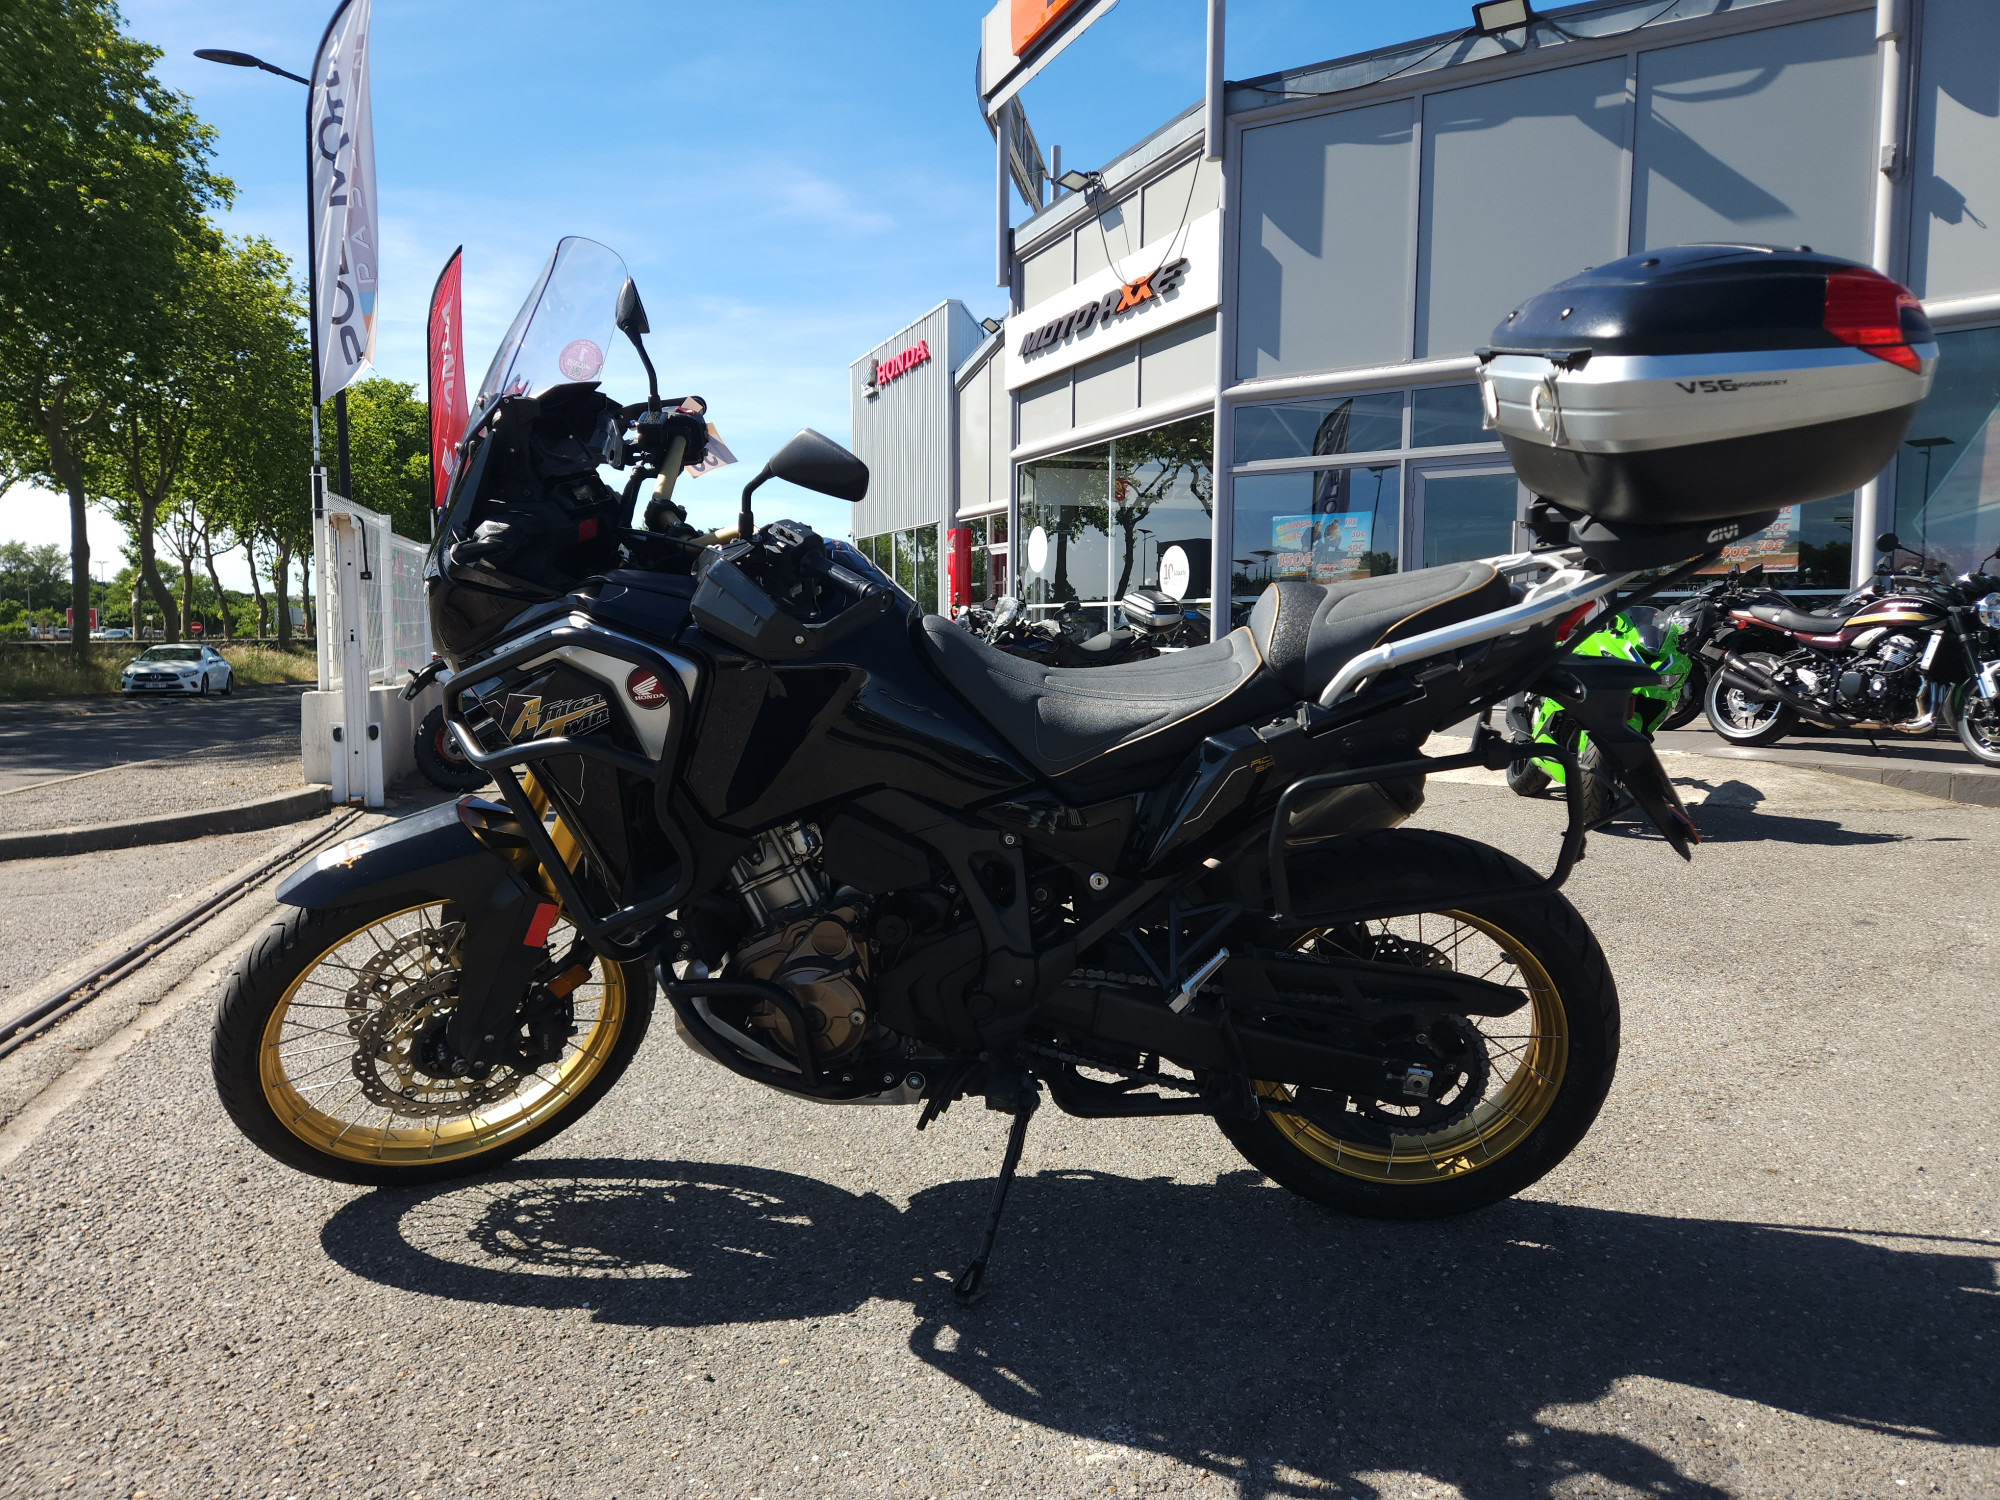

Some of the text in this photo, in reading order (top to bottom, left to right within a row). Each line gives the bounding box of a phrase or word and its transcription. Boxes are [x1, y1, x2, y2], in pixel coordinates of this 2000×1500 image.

[876, 340, 930, 386] HONDA
[1675, 379, 1739, 394] V56
[1778, 505, 1793, 514] 0€
[1707, 524, 1739, 543] GIVI
[1721, 546, 1751, 558] 90€
[1757, 539, 1785, 551] 70€
[1277, 552, 1315, 567] 150€
[634, 693, 666, 701] HONDA
[533, 701, 610, 739] Twin
